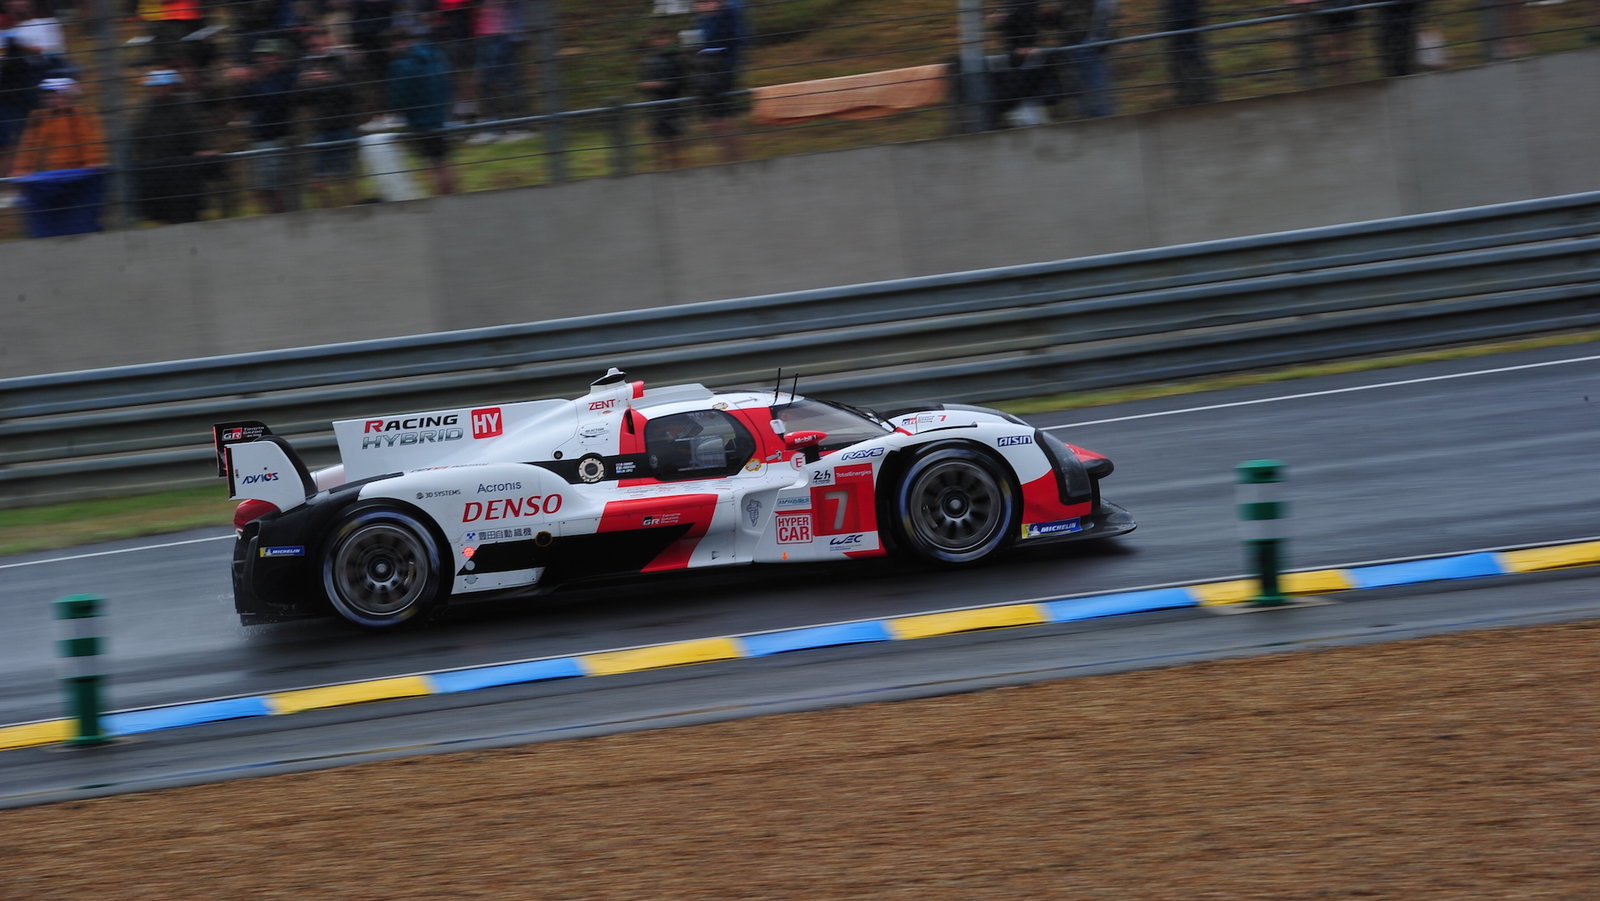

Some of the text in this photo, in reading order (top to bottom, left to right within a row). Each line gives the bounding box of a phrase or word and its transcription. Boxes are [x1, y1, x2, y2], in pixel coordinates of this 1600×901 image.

[589, 399, 616, 411] ZENT
[364, 414, 458, 434] RACING
[472, 412, 500, 434] HY
[223, 432, 241, 440] GR
[361, 427, 464, 450] HYBRID
[794, 435, 812, 444] Mobil
[999, 435, 1032, 447] AISIN
[841, 447, 885, 460] RAYS
[836, 470, 872, 478] TotalEnergies
[477, 481, 522, 494] Acronis
[425, 489, 462, 499] 3D SYSTEMS
[462, 494, 563, 523] DENSO
[824, 490, 849, 530] 7
[643, 518, 660, 526] GR
[778, 516, 809, 527] HYPER
[1040, 522, 1077, 533] MICHELIN
[779, 526, 810, 541] CAR
[829, 534, 863, 546] WEC
